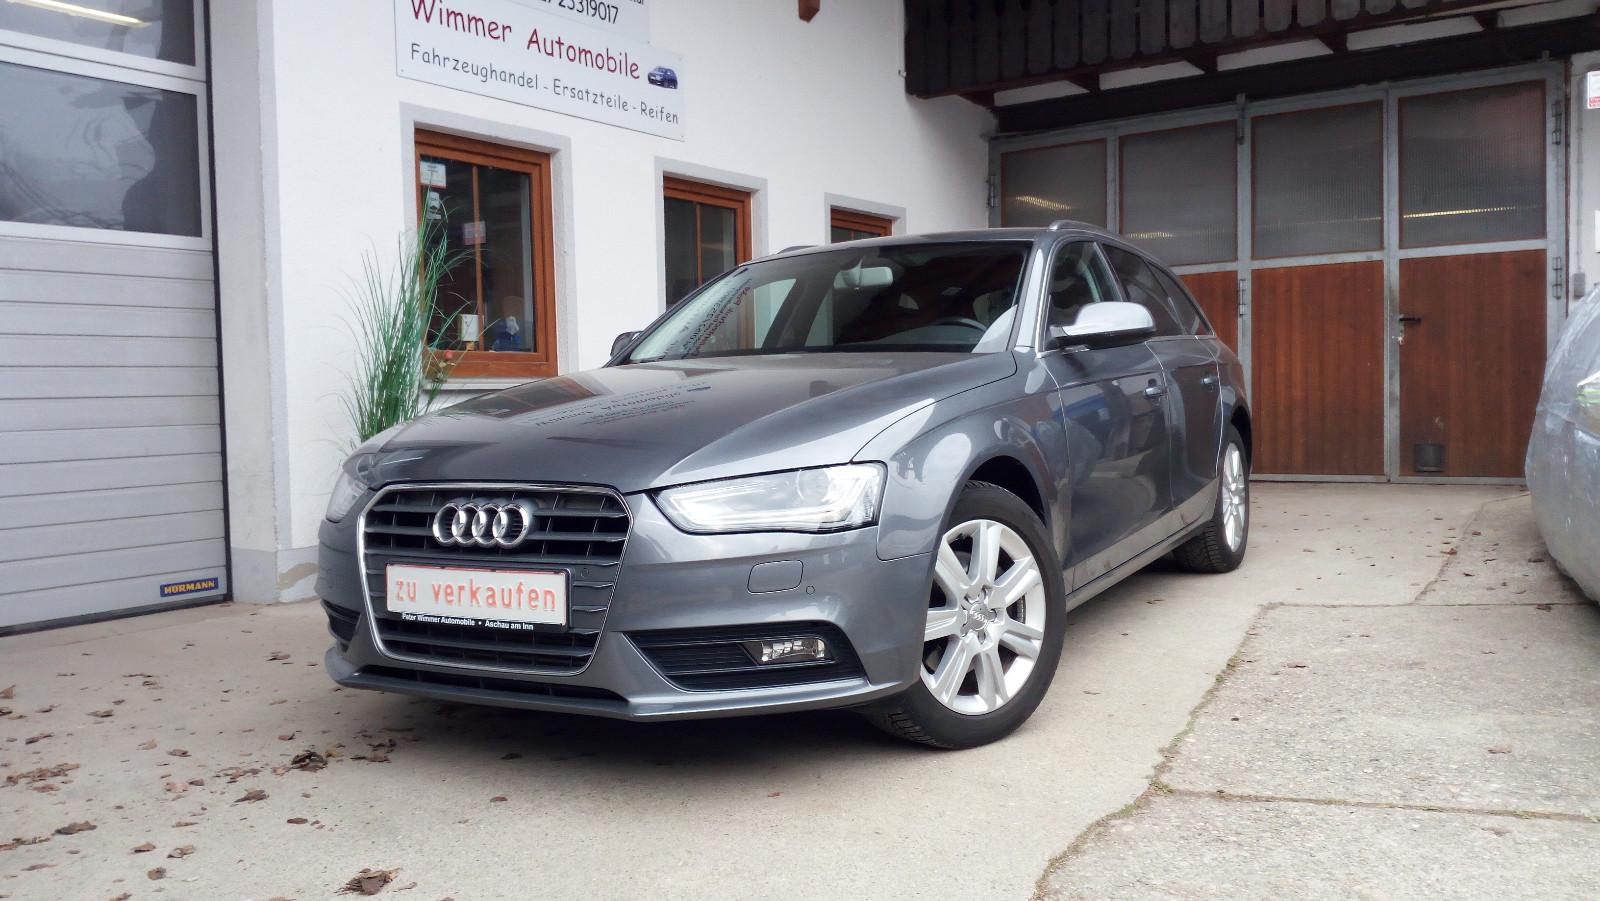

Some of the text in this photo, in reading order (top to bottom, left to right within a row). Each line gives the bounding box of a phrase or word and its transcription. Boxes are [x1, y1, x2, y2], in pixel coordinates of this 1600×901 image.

[411, 0, 641, 80] Wimmer Automobile
[410, 43, 539, 91] Fahrzeughandel
[553, 78, 629, 112] Ersatzteile
[640, 101, 679, 125] Reifen
[396, 578, 556, 612] zu verkaufen
[417, 614, 441, 623] Wimmer
[441, 616, 475, 626] Automobile
[485, 620, 509, 629] Aschau
[510, 622, 522, 630] am
[522, 622, 534, 631] Inn
